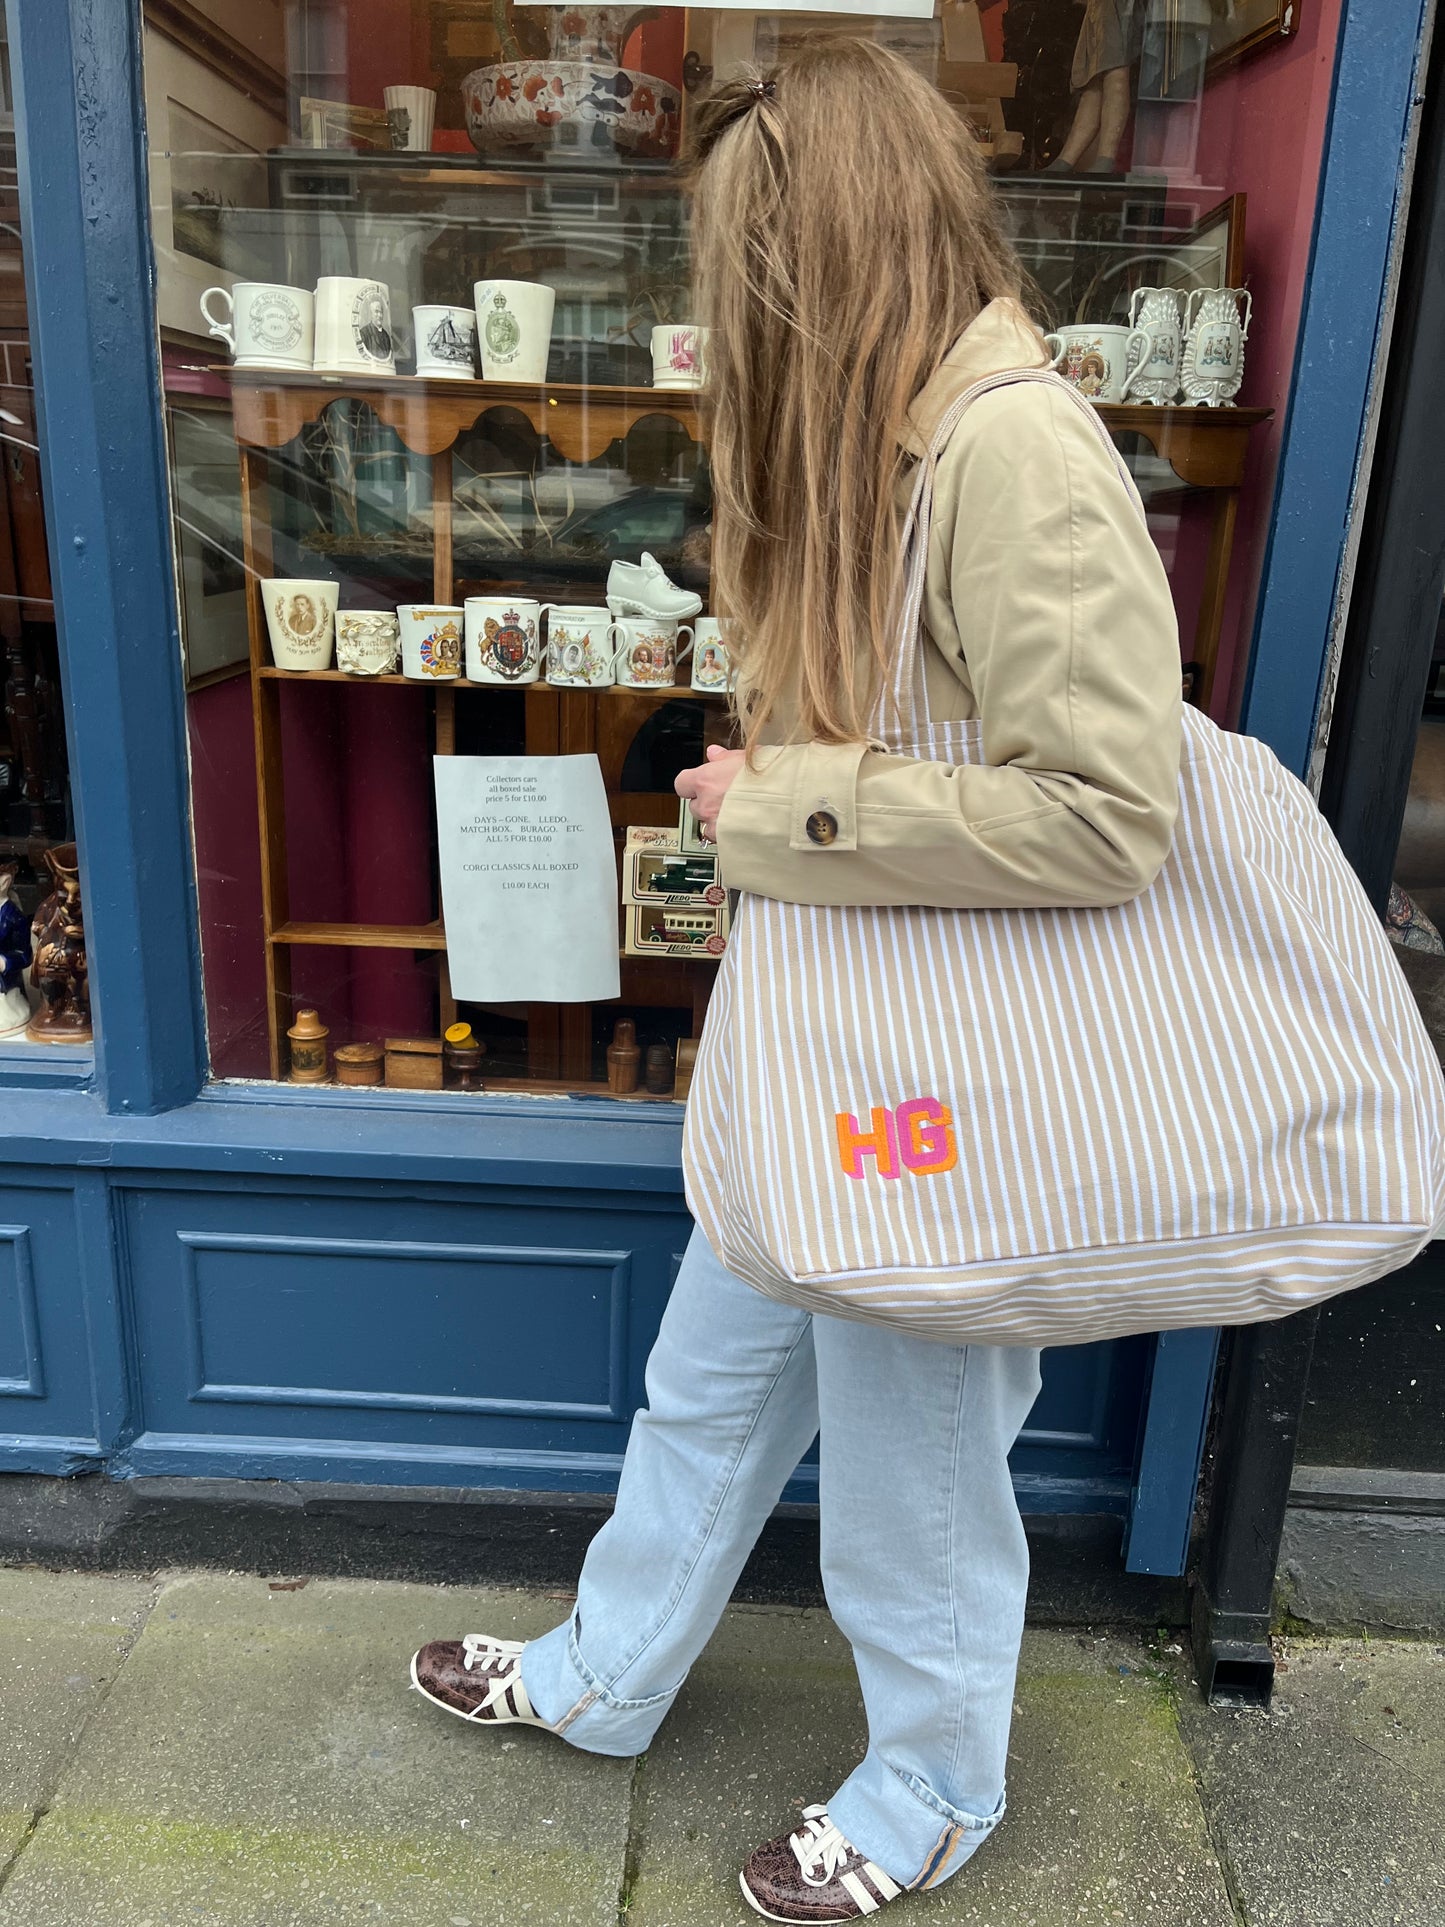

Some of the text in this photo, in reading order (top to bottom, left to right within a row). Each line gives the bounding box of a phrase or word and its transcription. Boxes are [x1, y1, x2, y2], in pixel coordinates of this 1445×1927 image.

[500, 785, 521, 793] boxed
[485, 795, 503, 804] price
[474, 816, 497, 824] DAYS
[566, 825, 584, 833] ETC.
[528, 835, 552, 843] £10.00
[491, 863, 531, 871] CLASSICS
[532, 863, 548, 871] ALL
[549, 863, 579, 871] BOXED
[527, 882, 550, 890] EACH
[664, 894, 691, 906] LLEDO
[665, 944, 692, 955] LLEDO
[835, 1096, 958, 1180] HG
